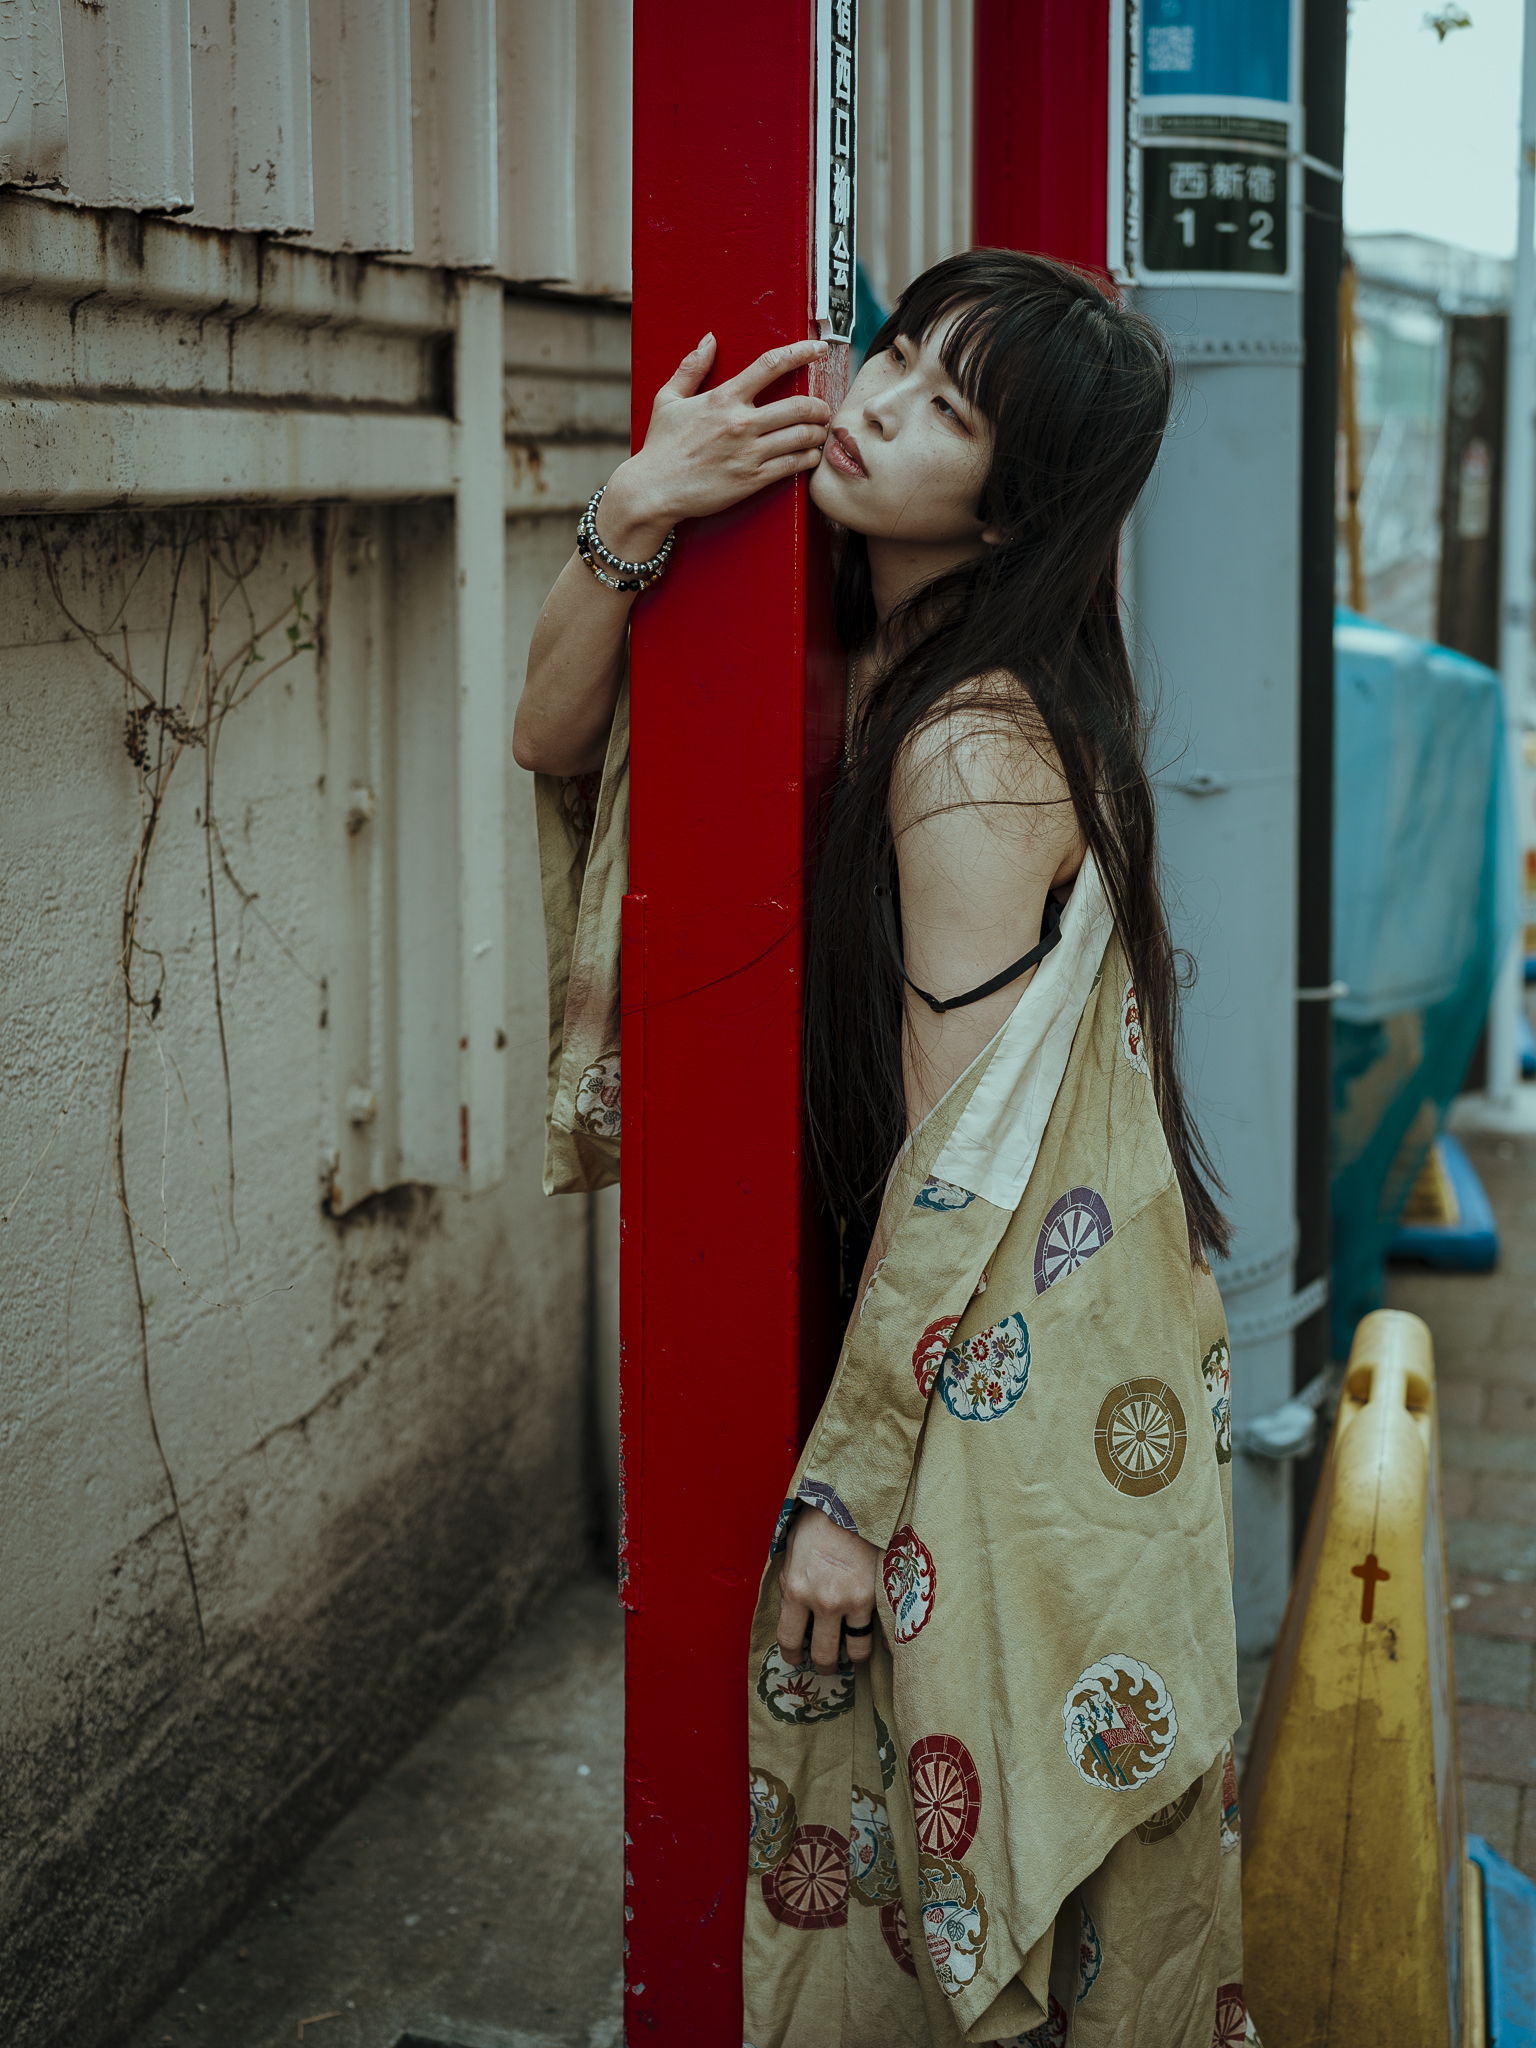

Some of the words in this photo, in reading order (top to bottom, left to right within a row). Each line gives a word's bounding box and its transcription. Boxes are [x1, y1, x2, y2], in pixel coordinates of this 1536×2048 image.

[1169, 161, 1276, 202] 西新宿
[1173, 207, 1275, 250] 1-2
